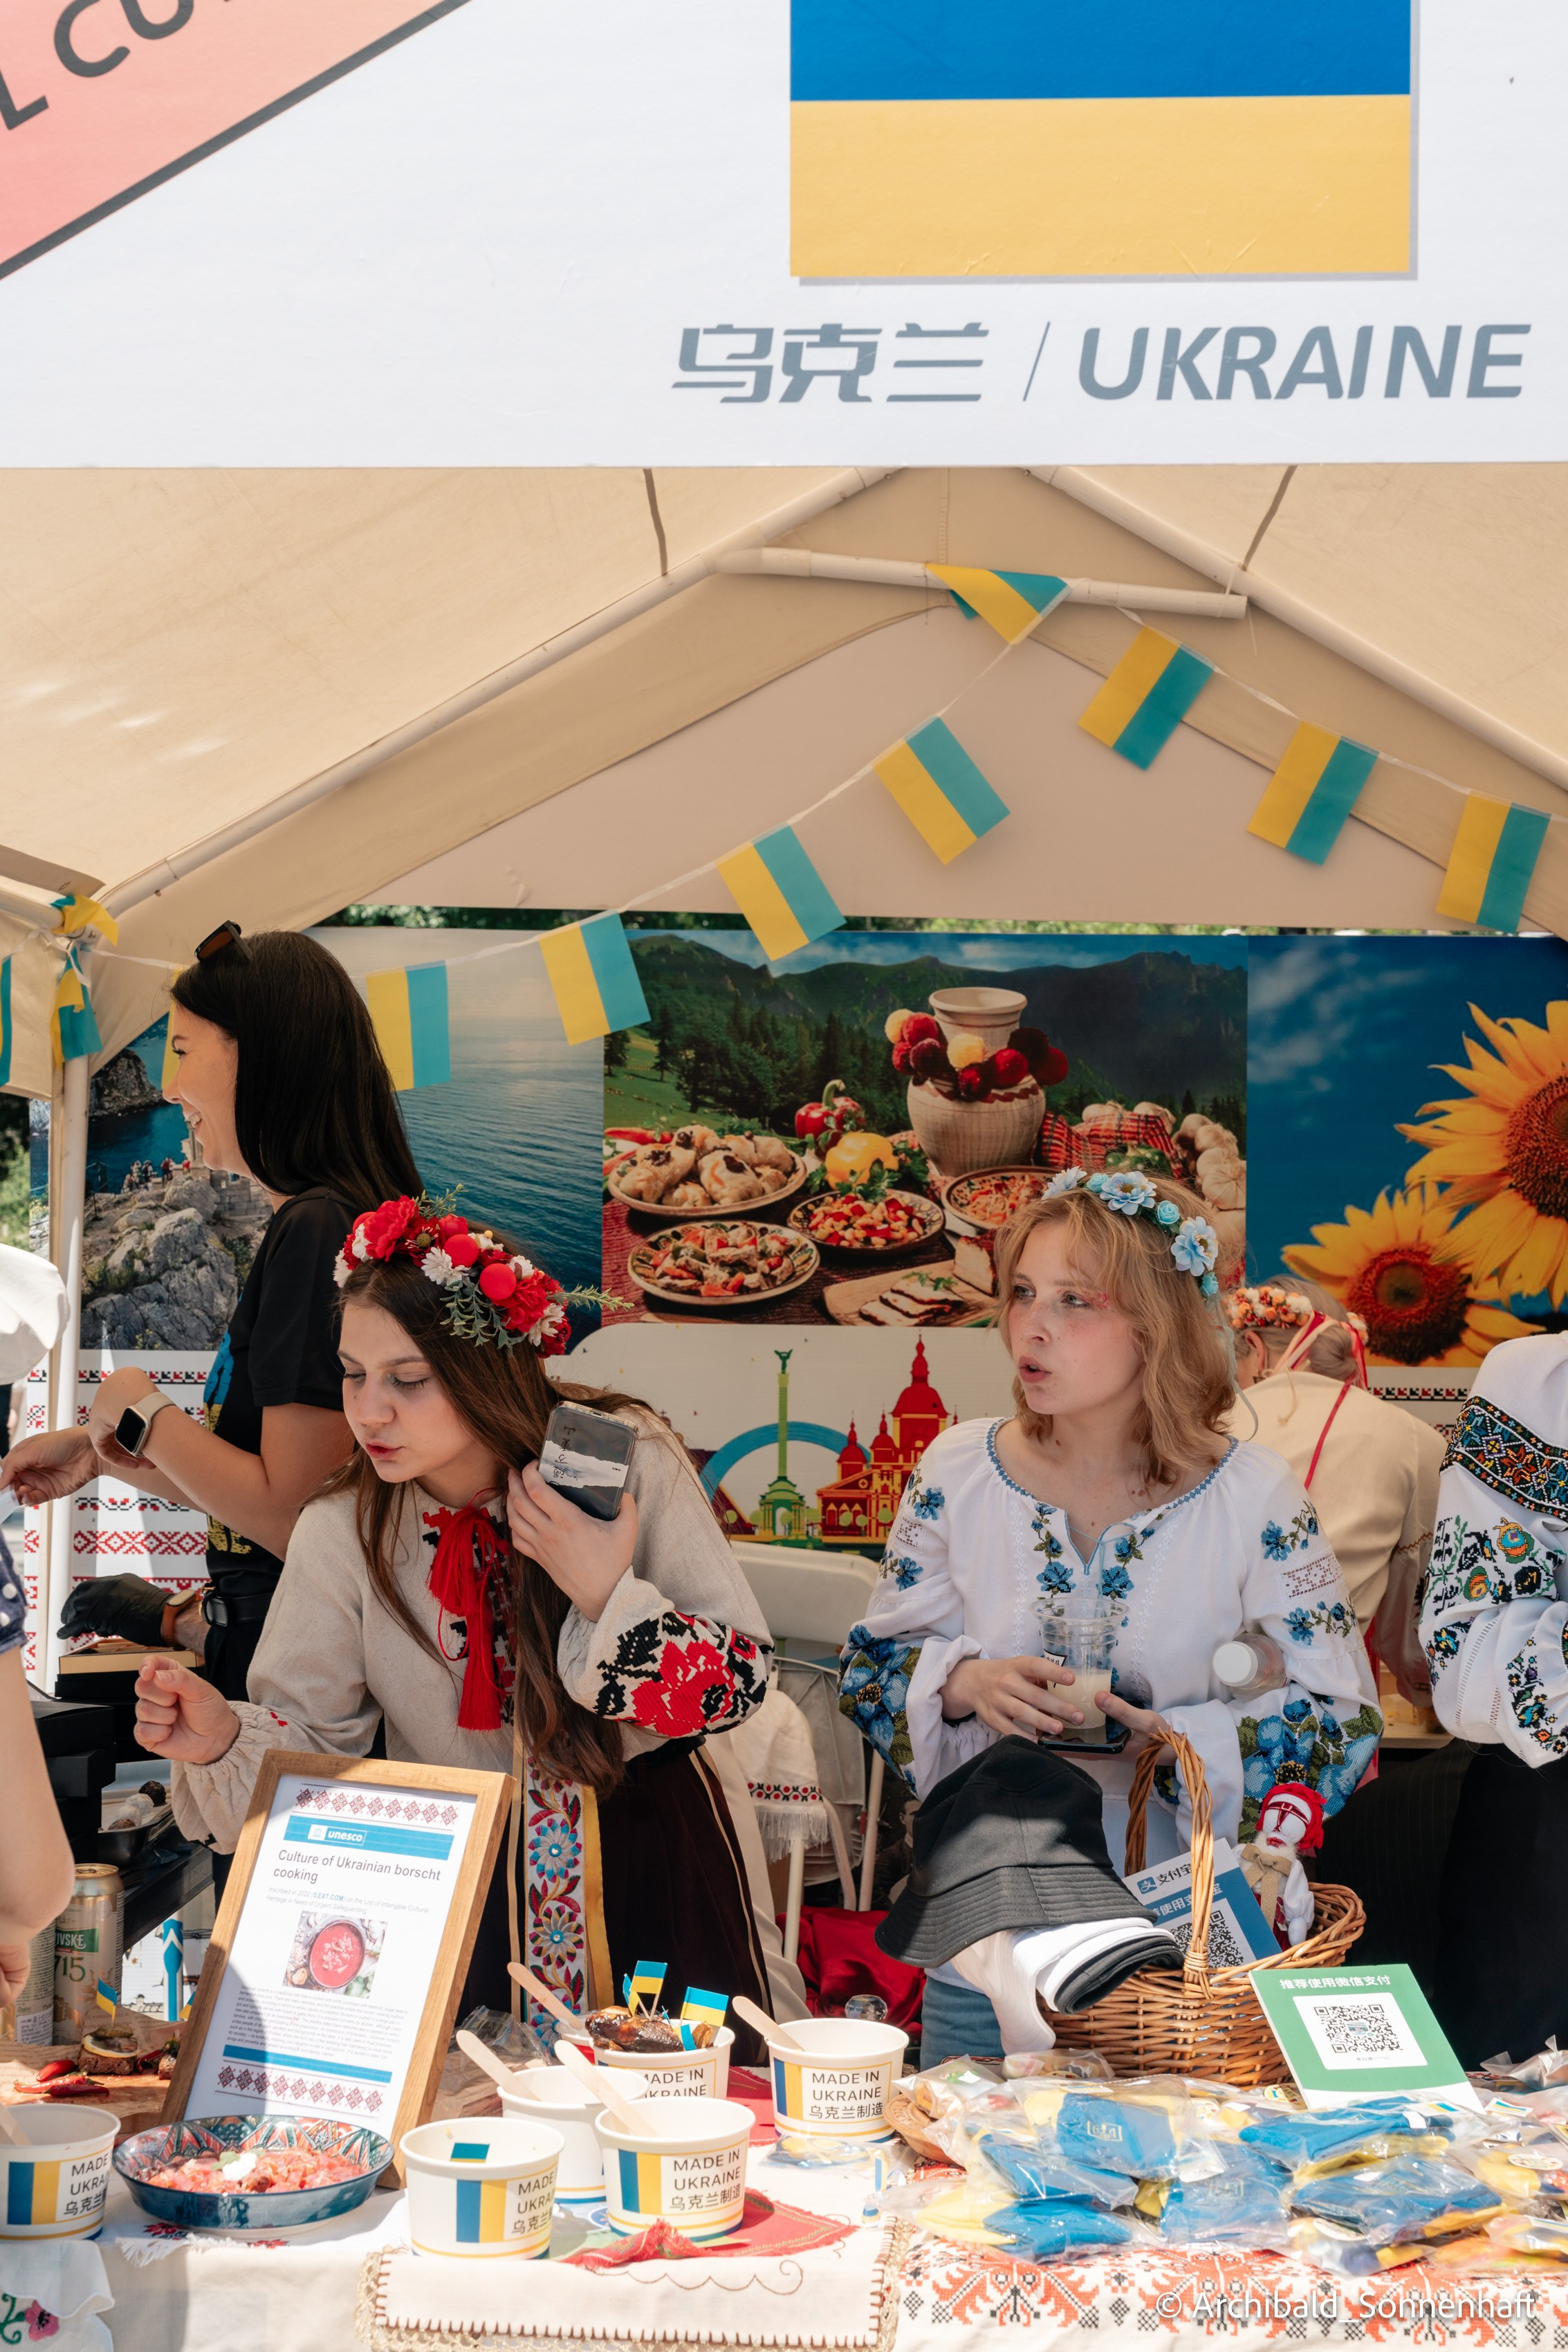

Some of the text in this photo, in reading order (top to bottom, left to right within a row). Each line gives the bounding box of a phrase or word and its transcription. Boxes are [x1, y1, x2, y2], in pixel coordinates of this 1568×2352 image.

[671, 322, 990, 403] 乌克兰
[1078, 324, 1531, 400] UKRAINE
[328, 1830, 362, 1842] unesco
[278, 1849, 441, 1881] Culture of Ukrainian borscht
[1156, 1863, 1192, 1886] 支付宝
[274, 1868, 318, 1884] cooking
[55, 1932, 86, 1949] IVSKE
[1280, 1974, 1391, 1990] 推荐使用微信支付
[644, 2068, 703, 2084] ADE IN
[812, 2070, 879, 2084] MADE IN
[645, 2084, 707, 2098] KRAINE
[813, 2086, 881, 2101] UKRAINE
[809, 2102, 883, 2120] 乌克兰制造
[71, 2153, 109, 2176] MADE
[674, 2149, 740, 2172] MADE IN
[518, 2171, 553, 2195] MADE
[674, 2166, 741, 2190] UKRAINE
[670, 2183, 741, 2211] 乌克兰制造
[511, 2207, 553, 2234] 乌克兰
